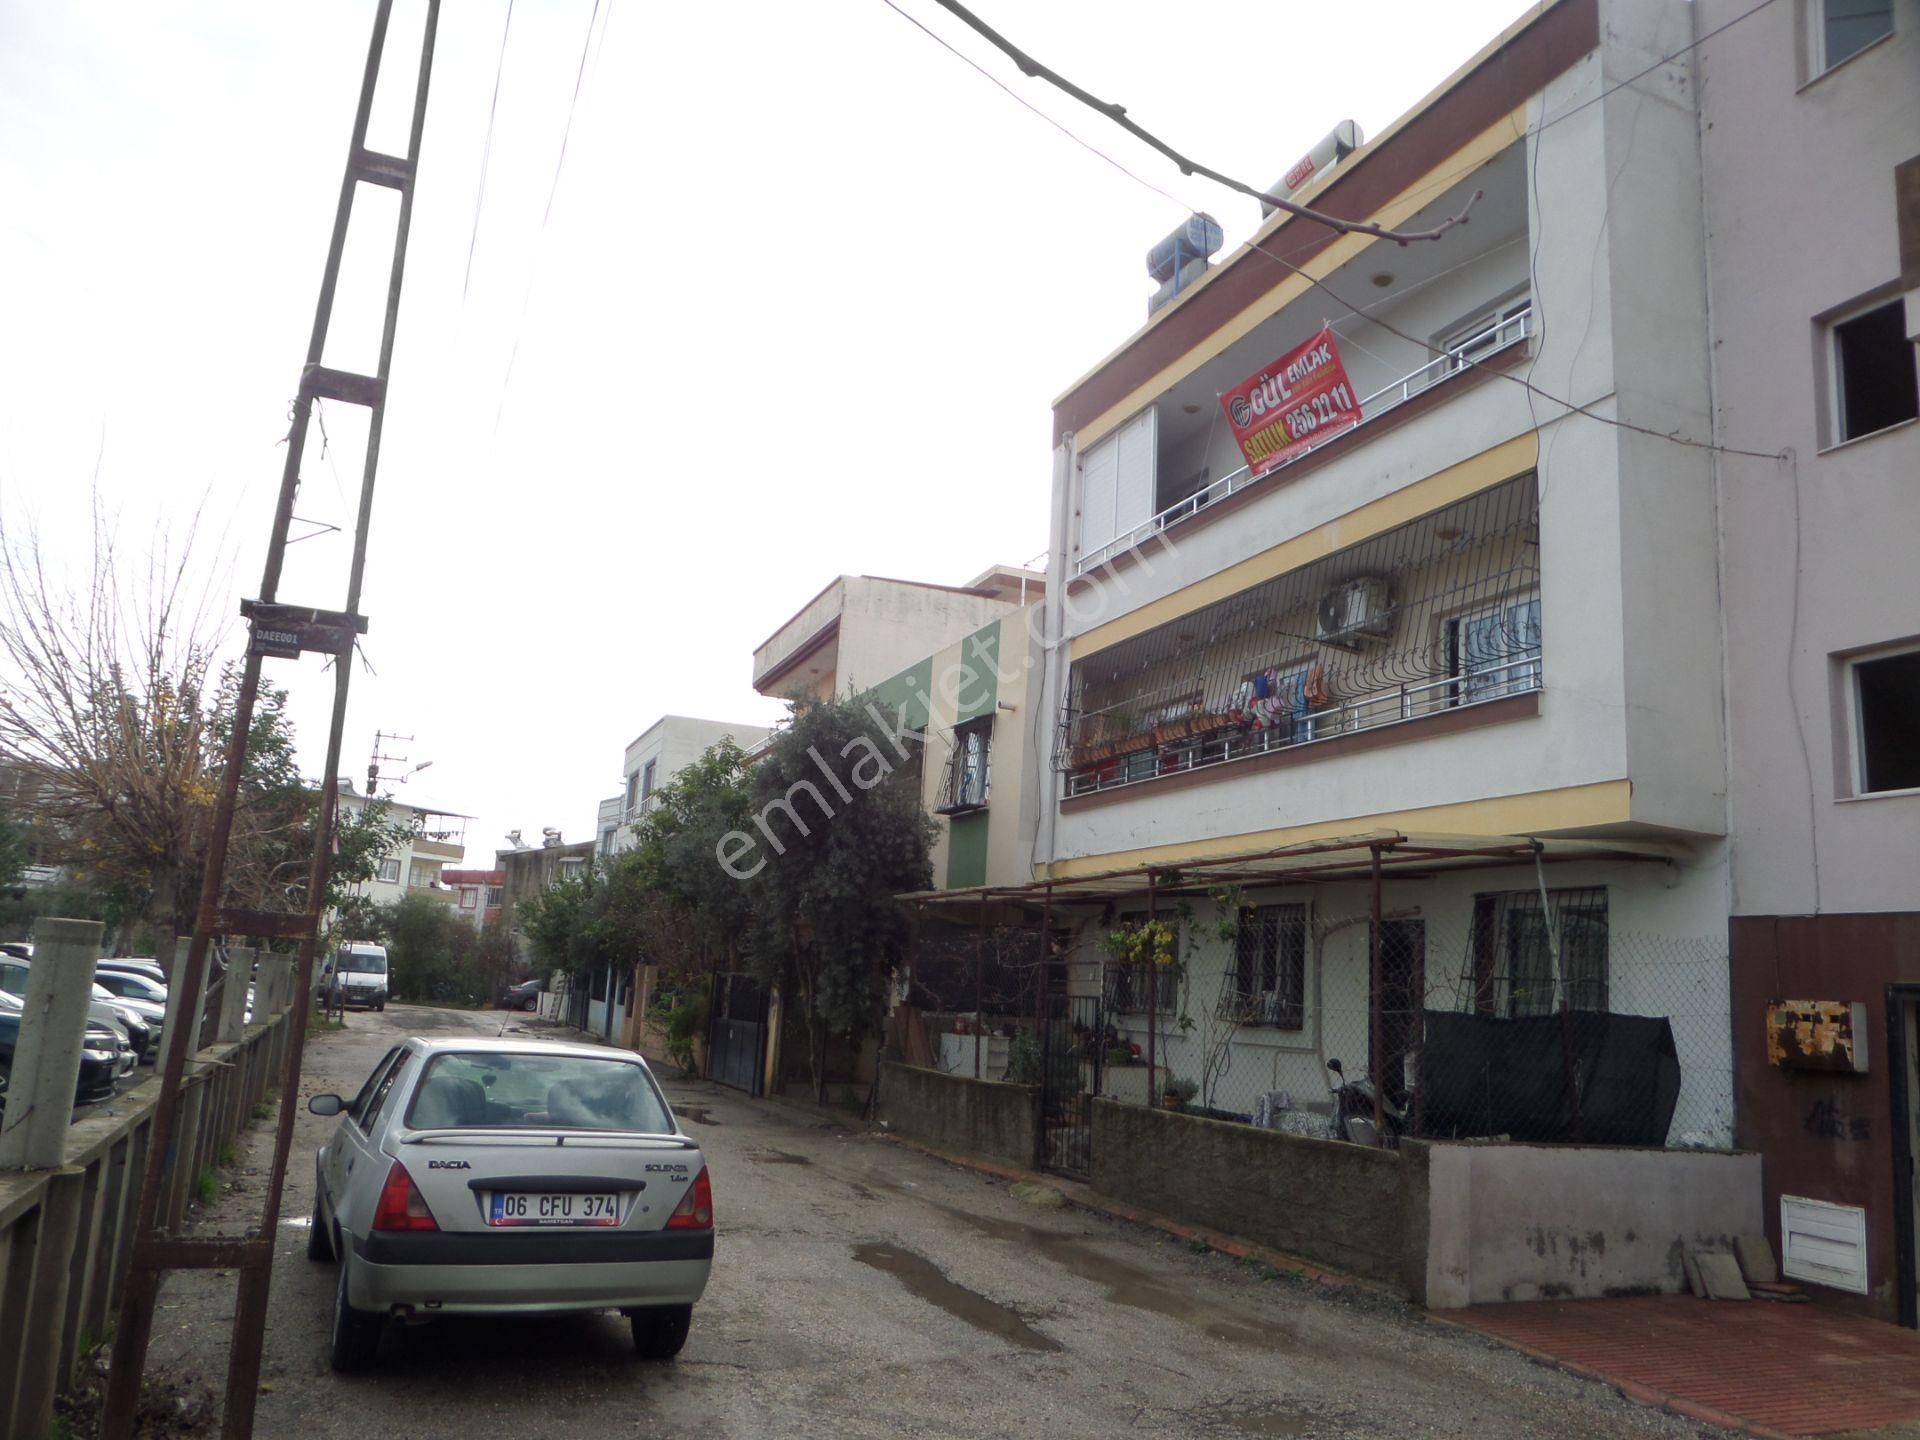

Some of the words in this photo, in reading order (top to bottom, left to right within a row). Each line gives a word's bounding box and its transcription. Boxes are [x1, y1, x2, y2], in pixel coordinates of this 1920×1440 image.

[1250, 373, 1292, 416] GÜL
[1287, 342, 1332, 384] EMLAK
[1244, 419, 1292, 464] SATILIK
[1286, 403, 1317, 440] 256
[1312, 392, 1338, 425] 22
[1330, 382, 1353, 412] 11
[428, 1160, 472, 1170] DACIA
[505, 1196, 527, 1217] 06
[539, 1196, 572, 1217] CFU
[583, 1196, 615, 1217] 374
